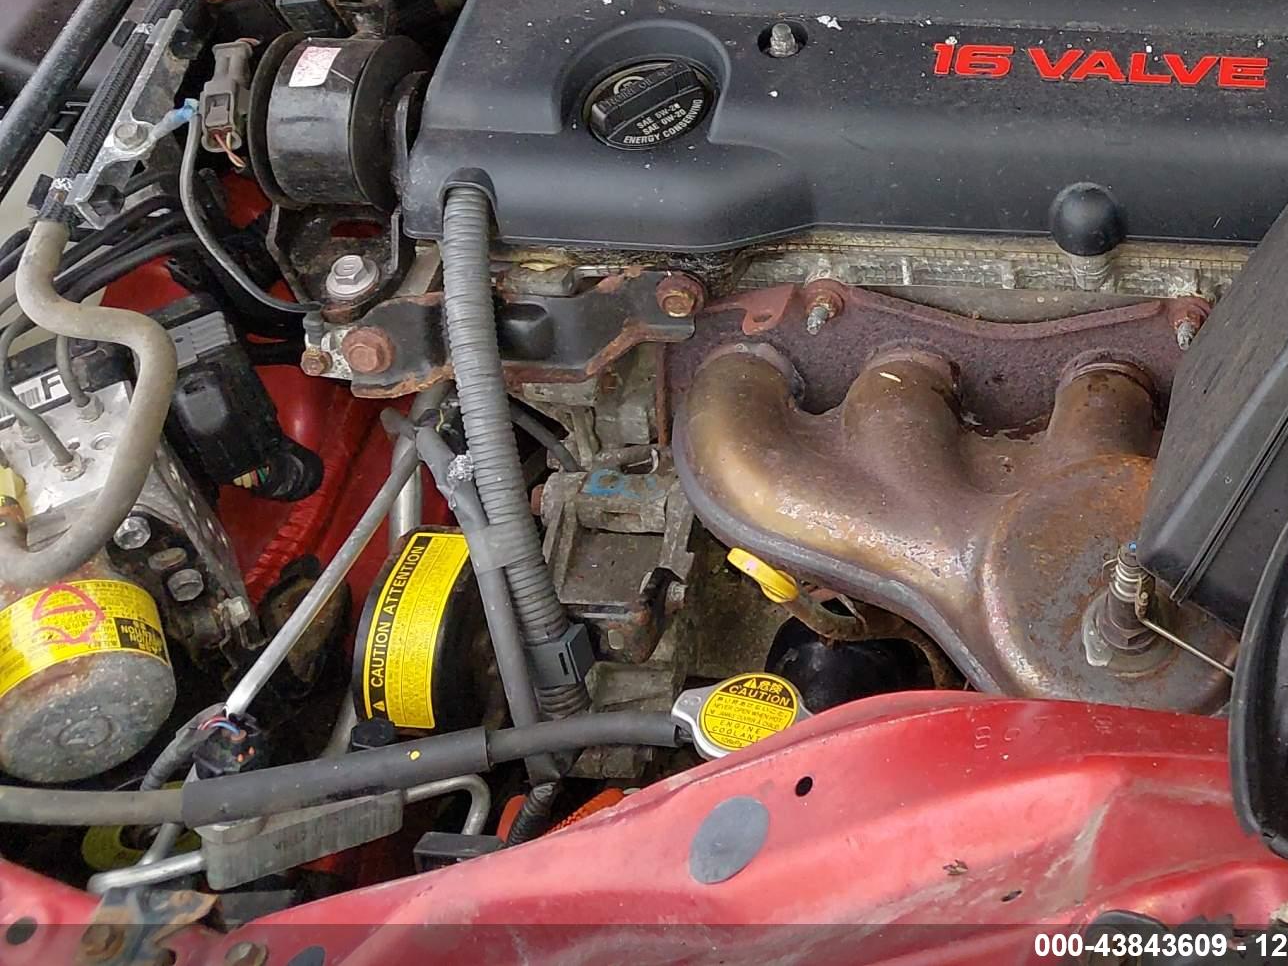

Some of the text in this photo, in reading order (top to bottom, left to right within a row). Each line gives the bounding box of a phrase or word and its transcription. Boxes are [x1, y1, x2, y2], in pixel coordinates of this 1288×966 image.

[934, 43, 1268, 89] 16 VALVE
[623, 99, 704, 144] ENERGY CONSERVING
[637, 116, 653, 129] SAE
[642, 108, 687, 136] SAE 0W-20
[40, 374, 61, 400] F
[371, 545, 424, 688] CAUTION ATTENTION
[728, 685, 792, 707] CAUTION
[719, 719, 762, 735] ENGINE
